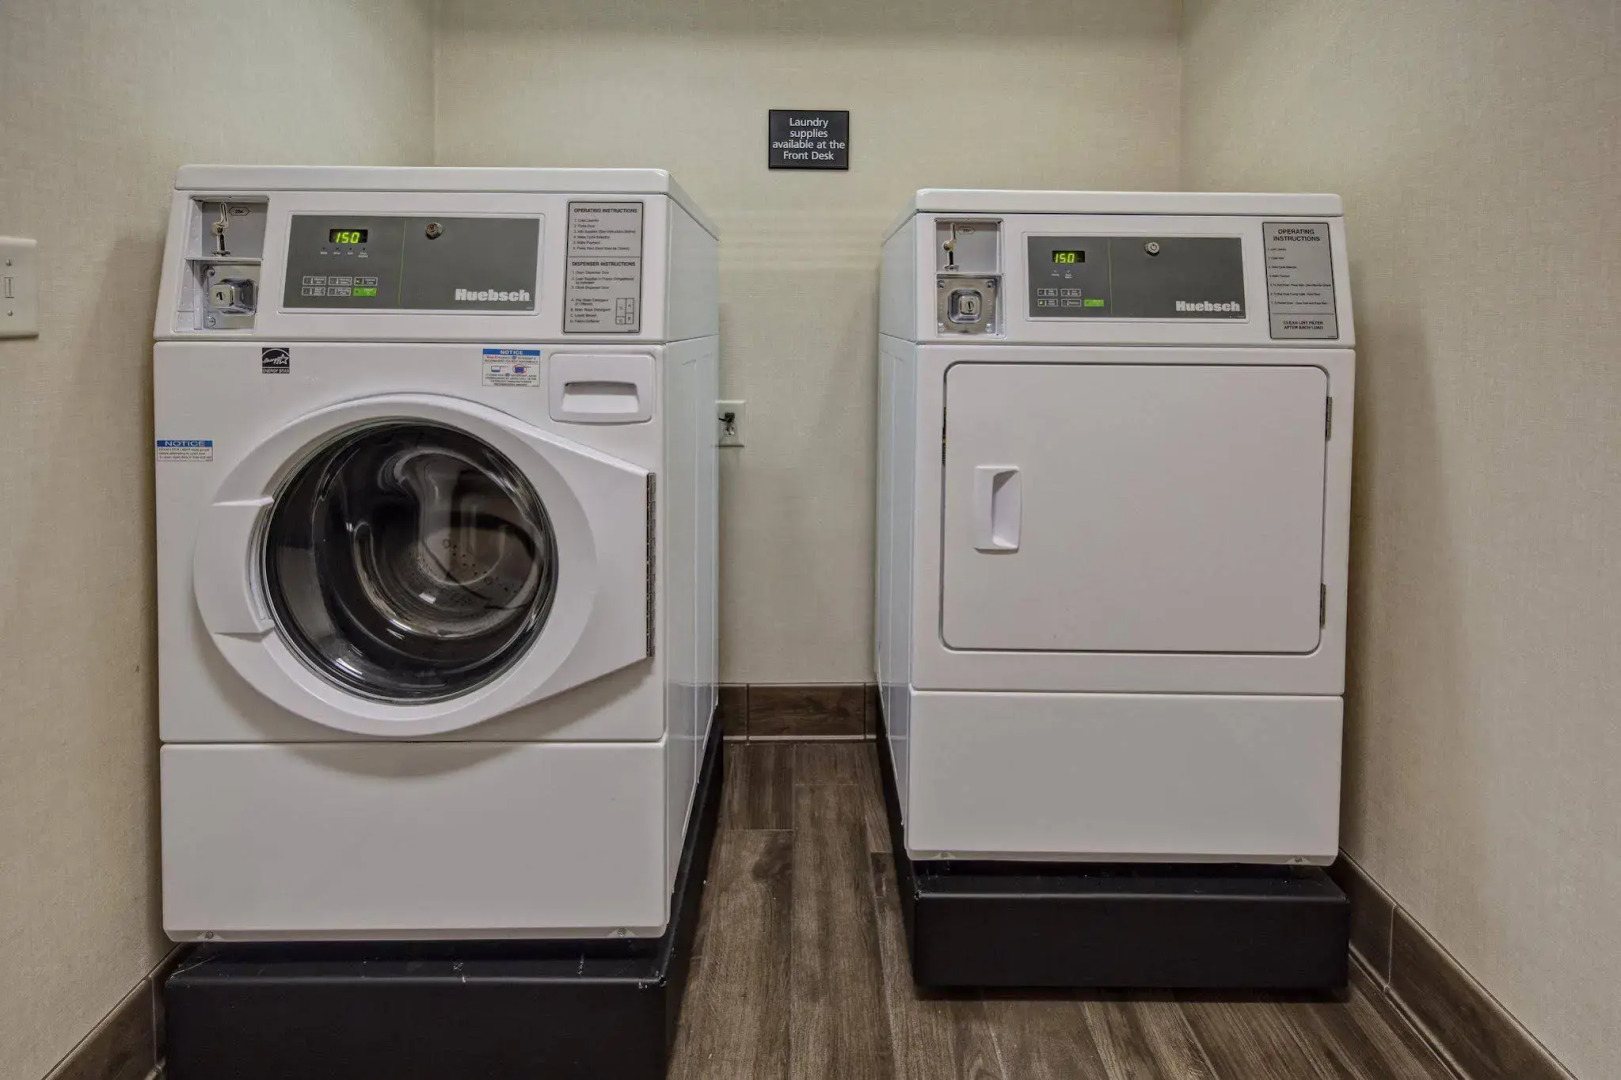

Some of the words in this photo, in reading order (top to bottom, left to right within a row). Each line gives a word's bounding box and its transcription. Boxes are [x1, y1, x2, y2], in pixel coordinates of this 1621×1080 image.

[789, 118, 829, 129] Laundry
[790, 129, 828, 139] supplies
[772, 140, 814, 149] available
[816, 141, 827, 149] at
[829, 140, 845, 149] the
[783, 151, 808, 160] Front
[811, 151, 834, 160] Desk
[335, 232, 360, 244] 150
[1055, 253, 1075, 264] 150
[455, 288, 531, 302] Huebsch
[1175, 300, 1241, 312] Huebsch
